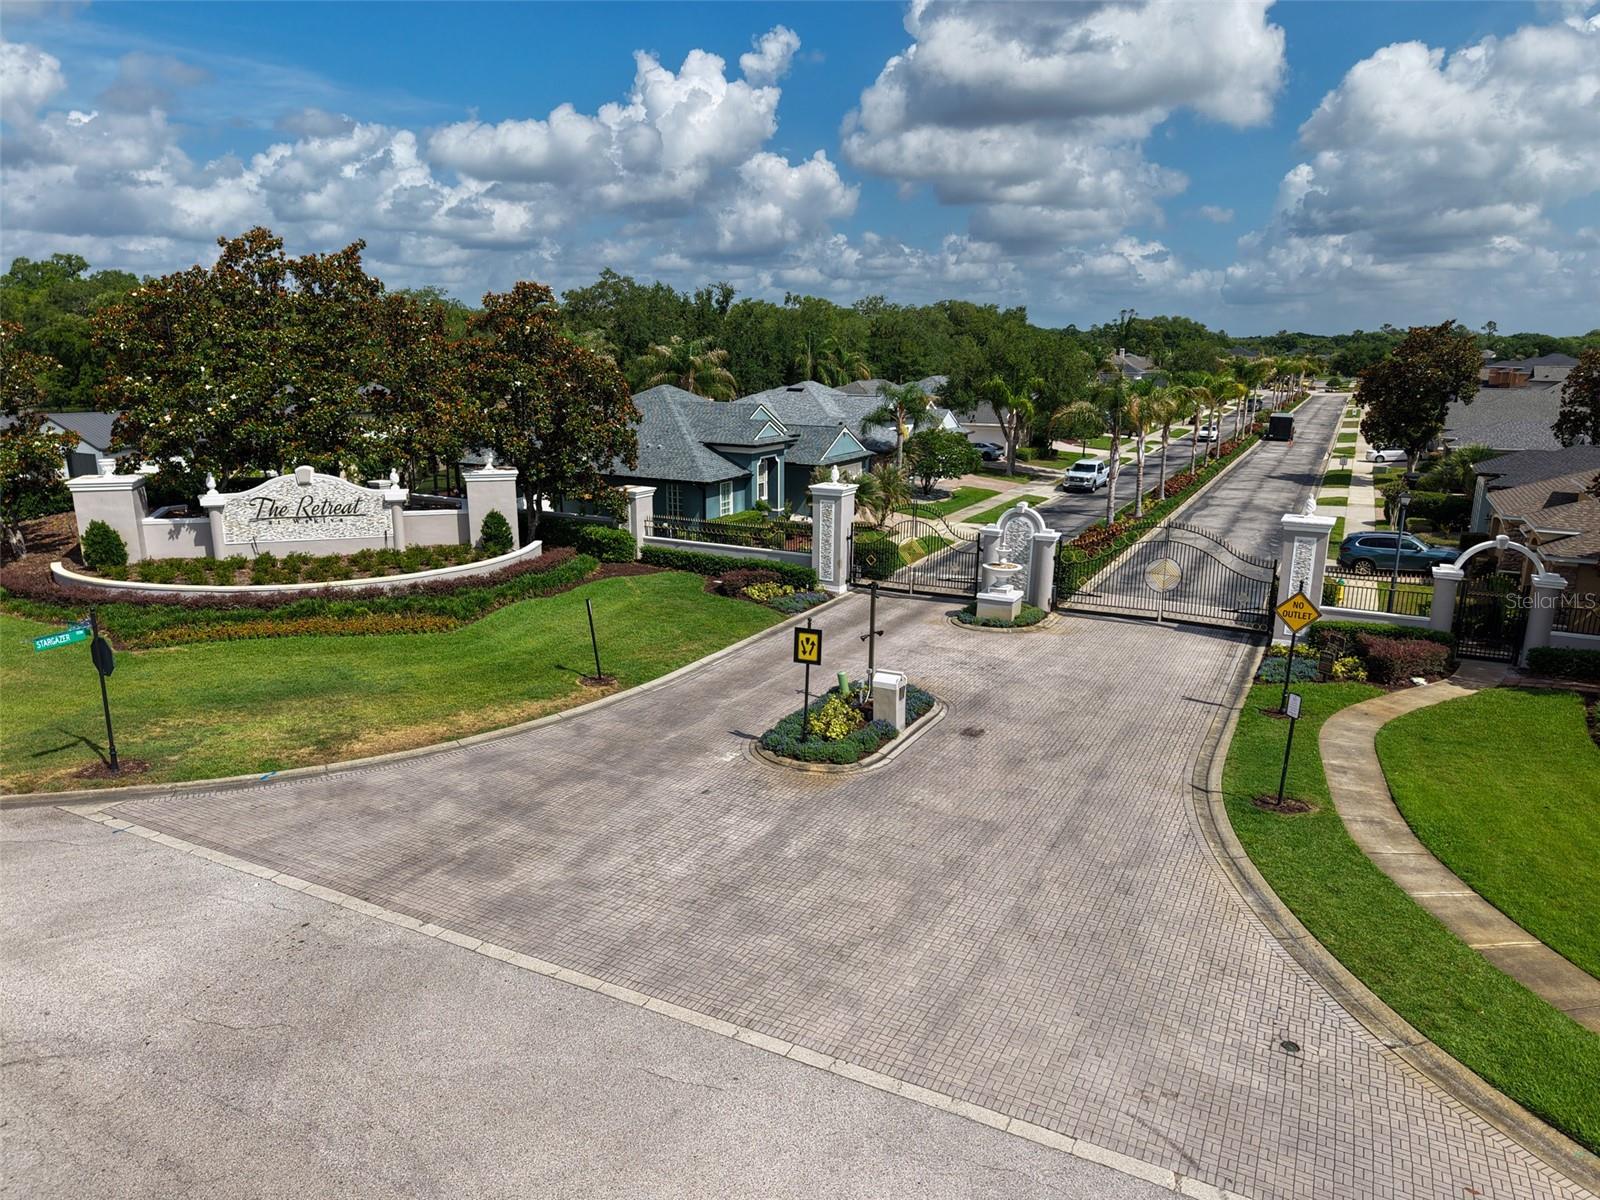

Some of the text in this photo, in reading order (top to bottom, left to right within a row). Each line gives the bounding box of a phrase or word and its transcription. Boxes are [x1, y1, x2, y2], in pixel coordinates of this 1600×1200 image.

[249, 495, 363, 520] The Retreat
[1292, 601, 1305, 610] NO
[1282, 609, 1313, 620] OUTLET
[36, 633, 71, 649] STARGAZER
